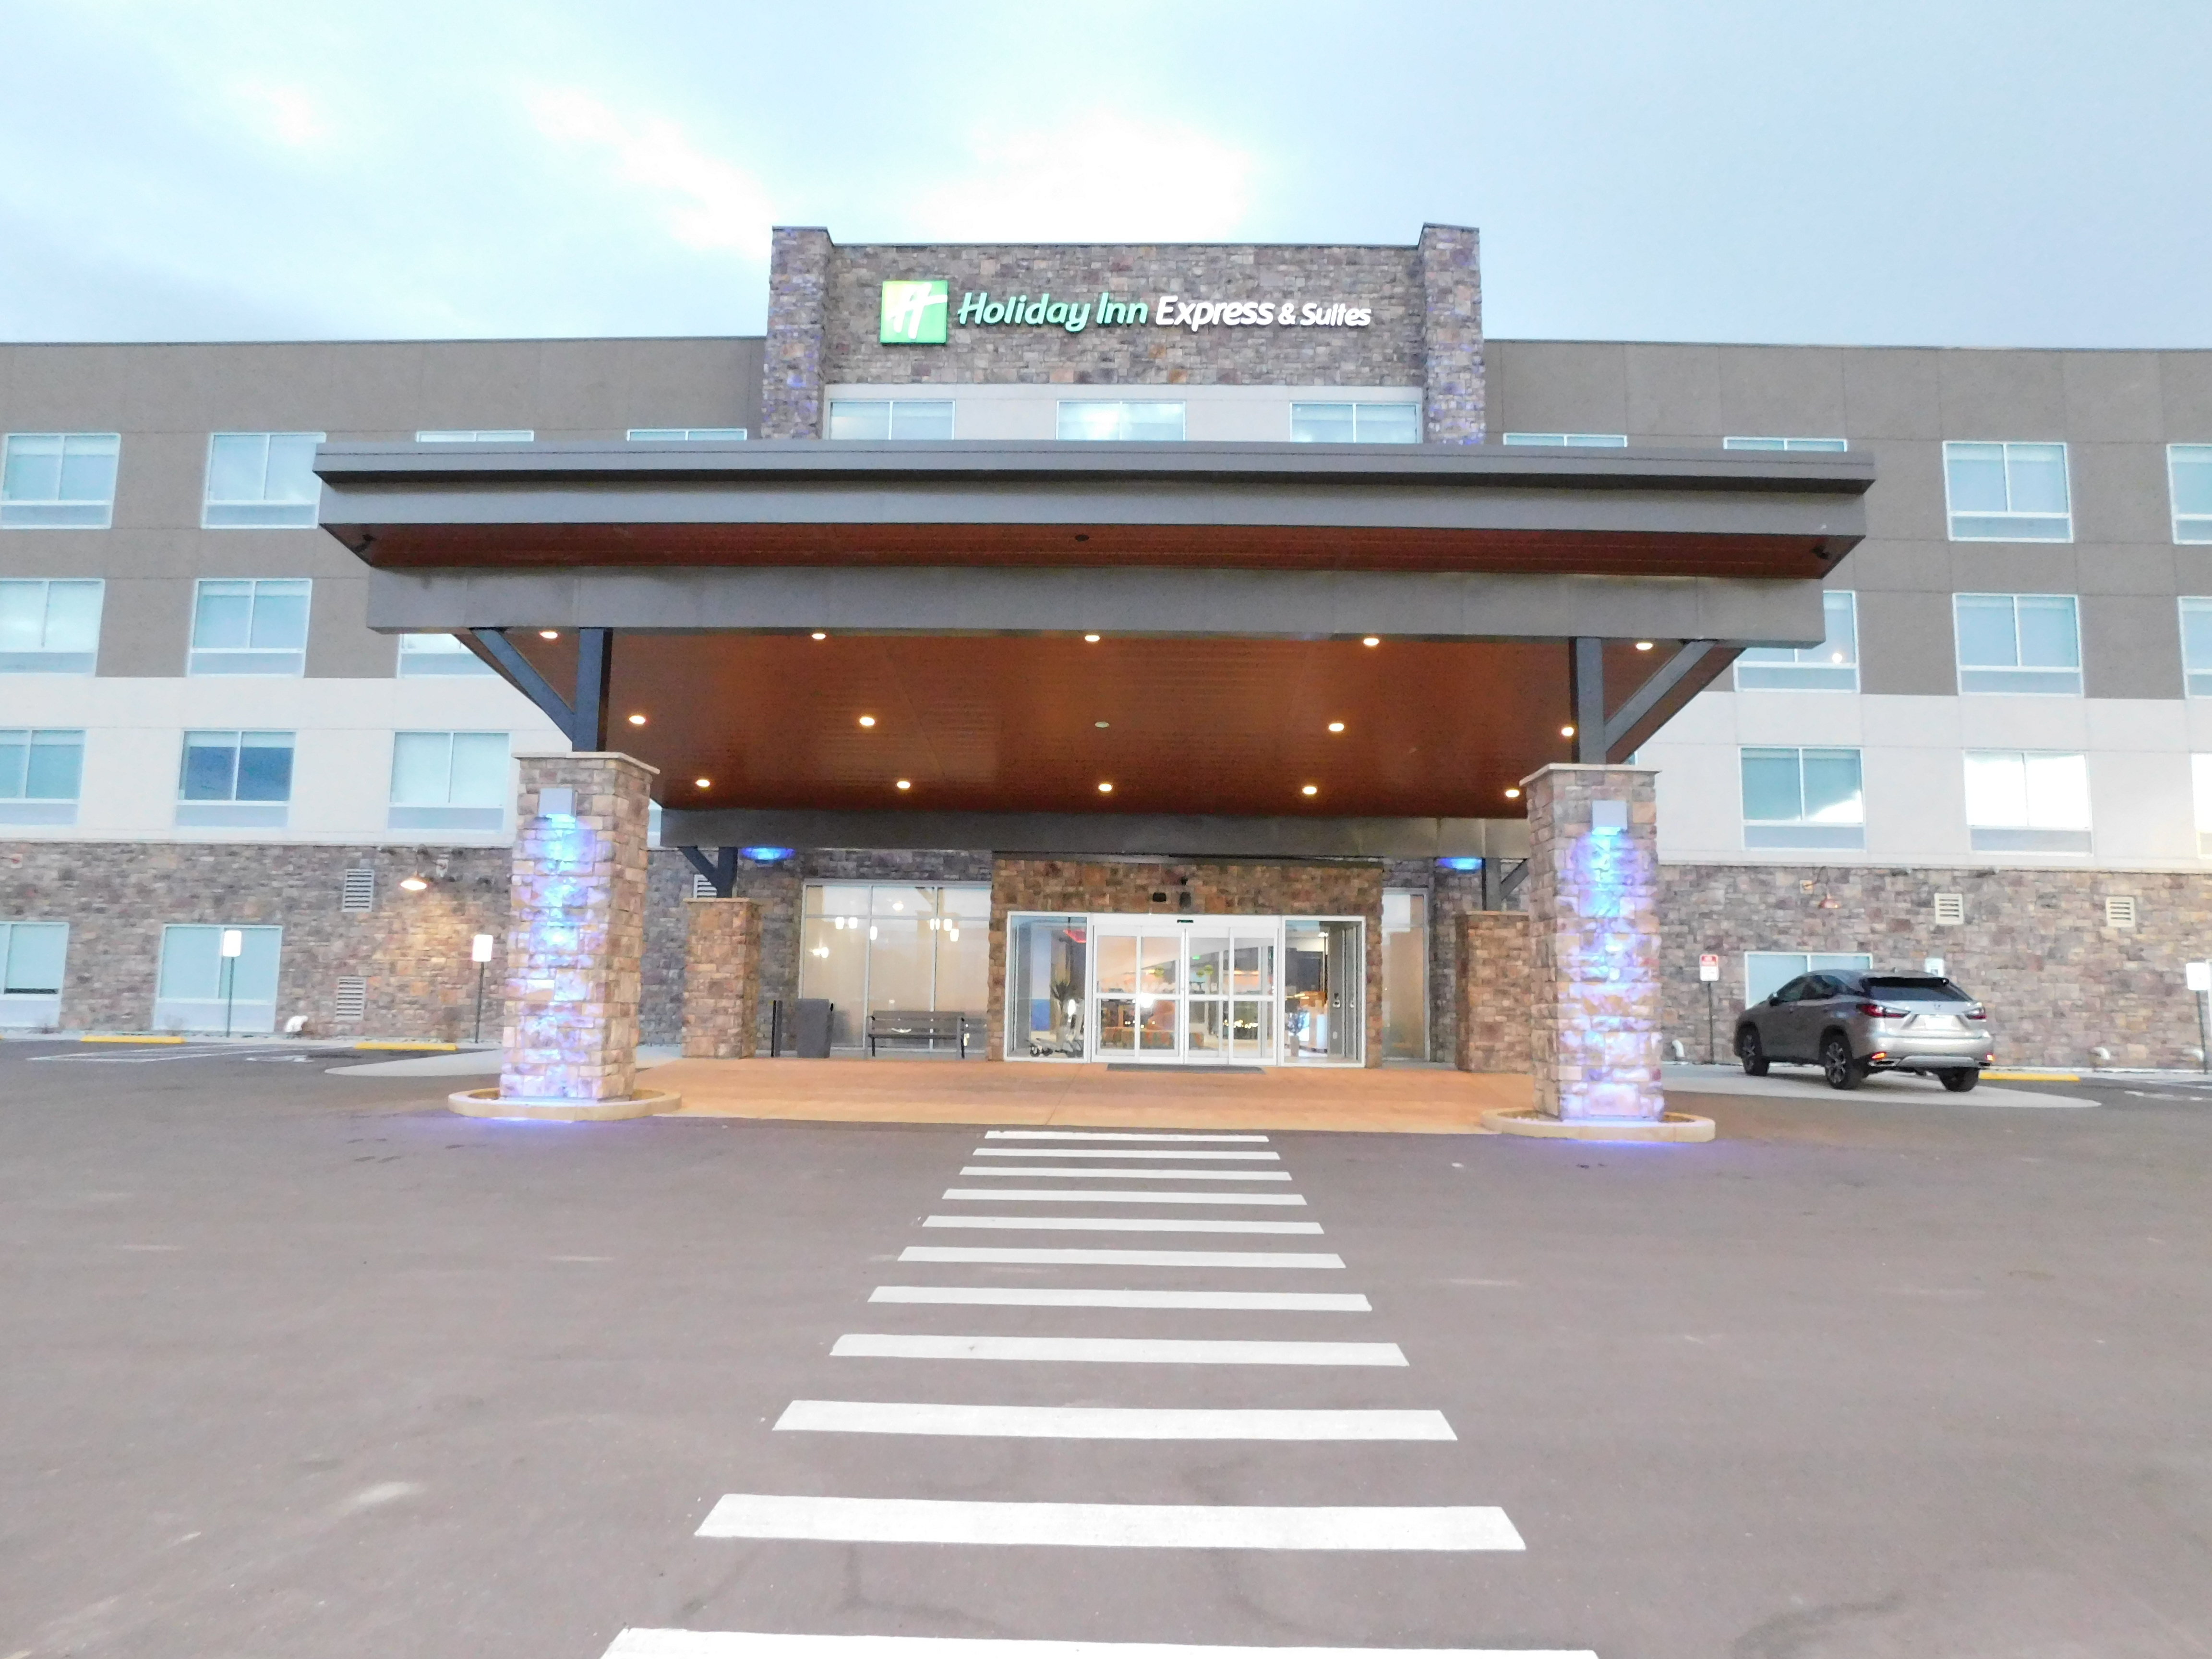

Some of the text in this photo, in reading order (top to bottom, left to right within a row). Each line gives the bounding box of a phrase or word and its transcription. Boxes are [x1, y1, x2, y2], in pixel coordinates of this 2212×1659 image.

[958, 291, 1372, 332] Holiday Inn Express & Suites
